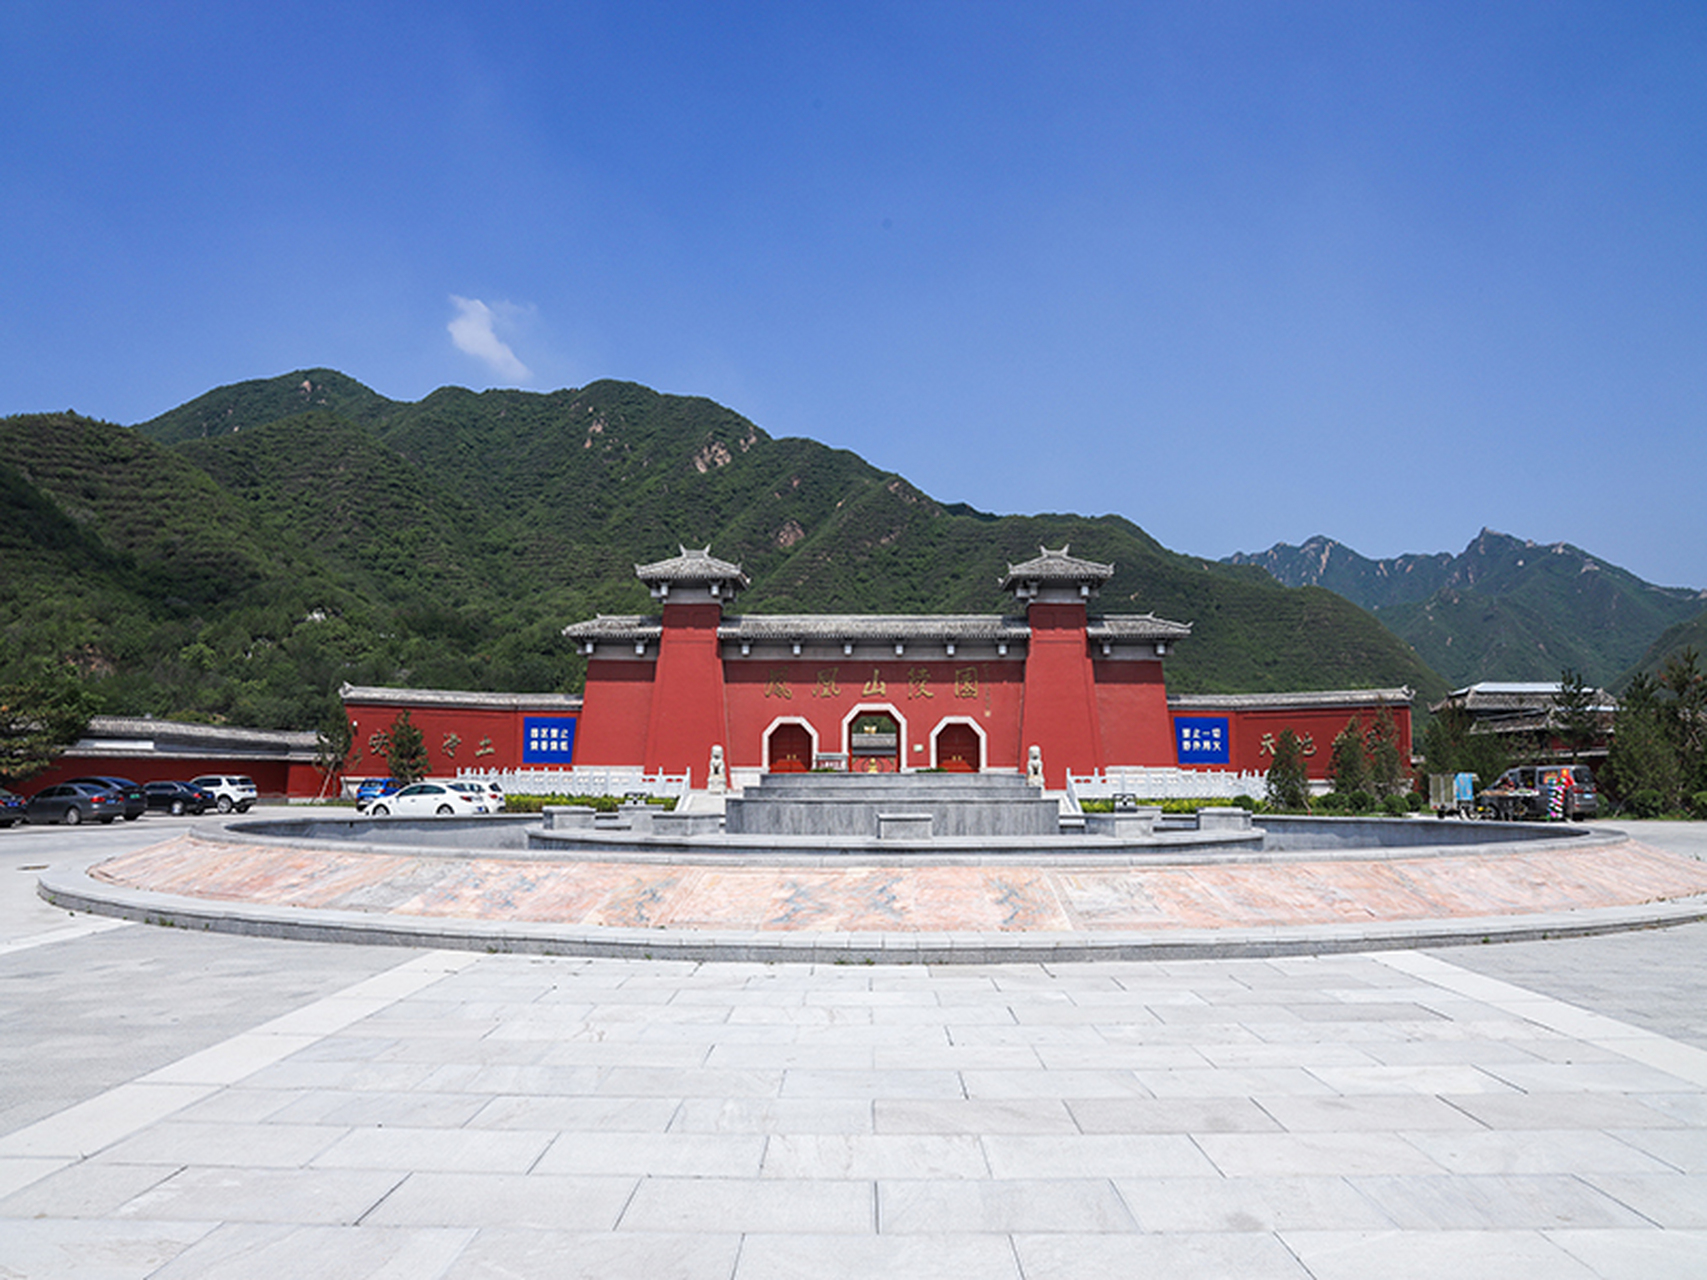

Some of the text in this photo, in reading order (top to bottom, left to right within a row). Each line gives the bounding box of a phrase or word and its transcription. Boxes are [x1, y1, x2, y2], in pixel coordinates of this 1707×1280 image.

[1182, 727, 1221, 739] 禁止一切
[1182, 740, 1222, 751] 野外用火
